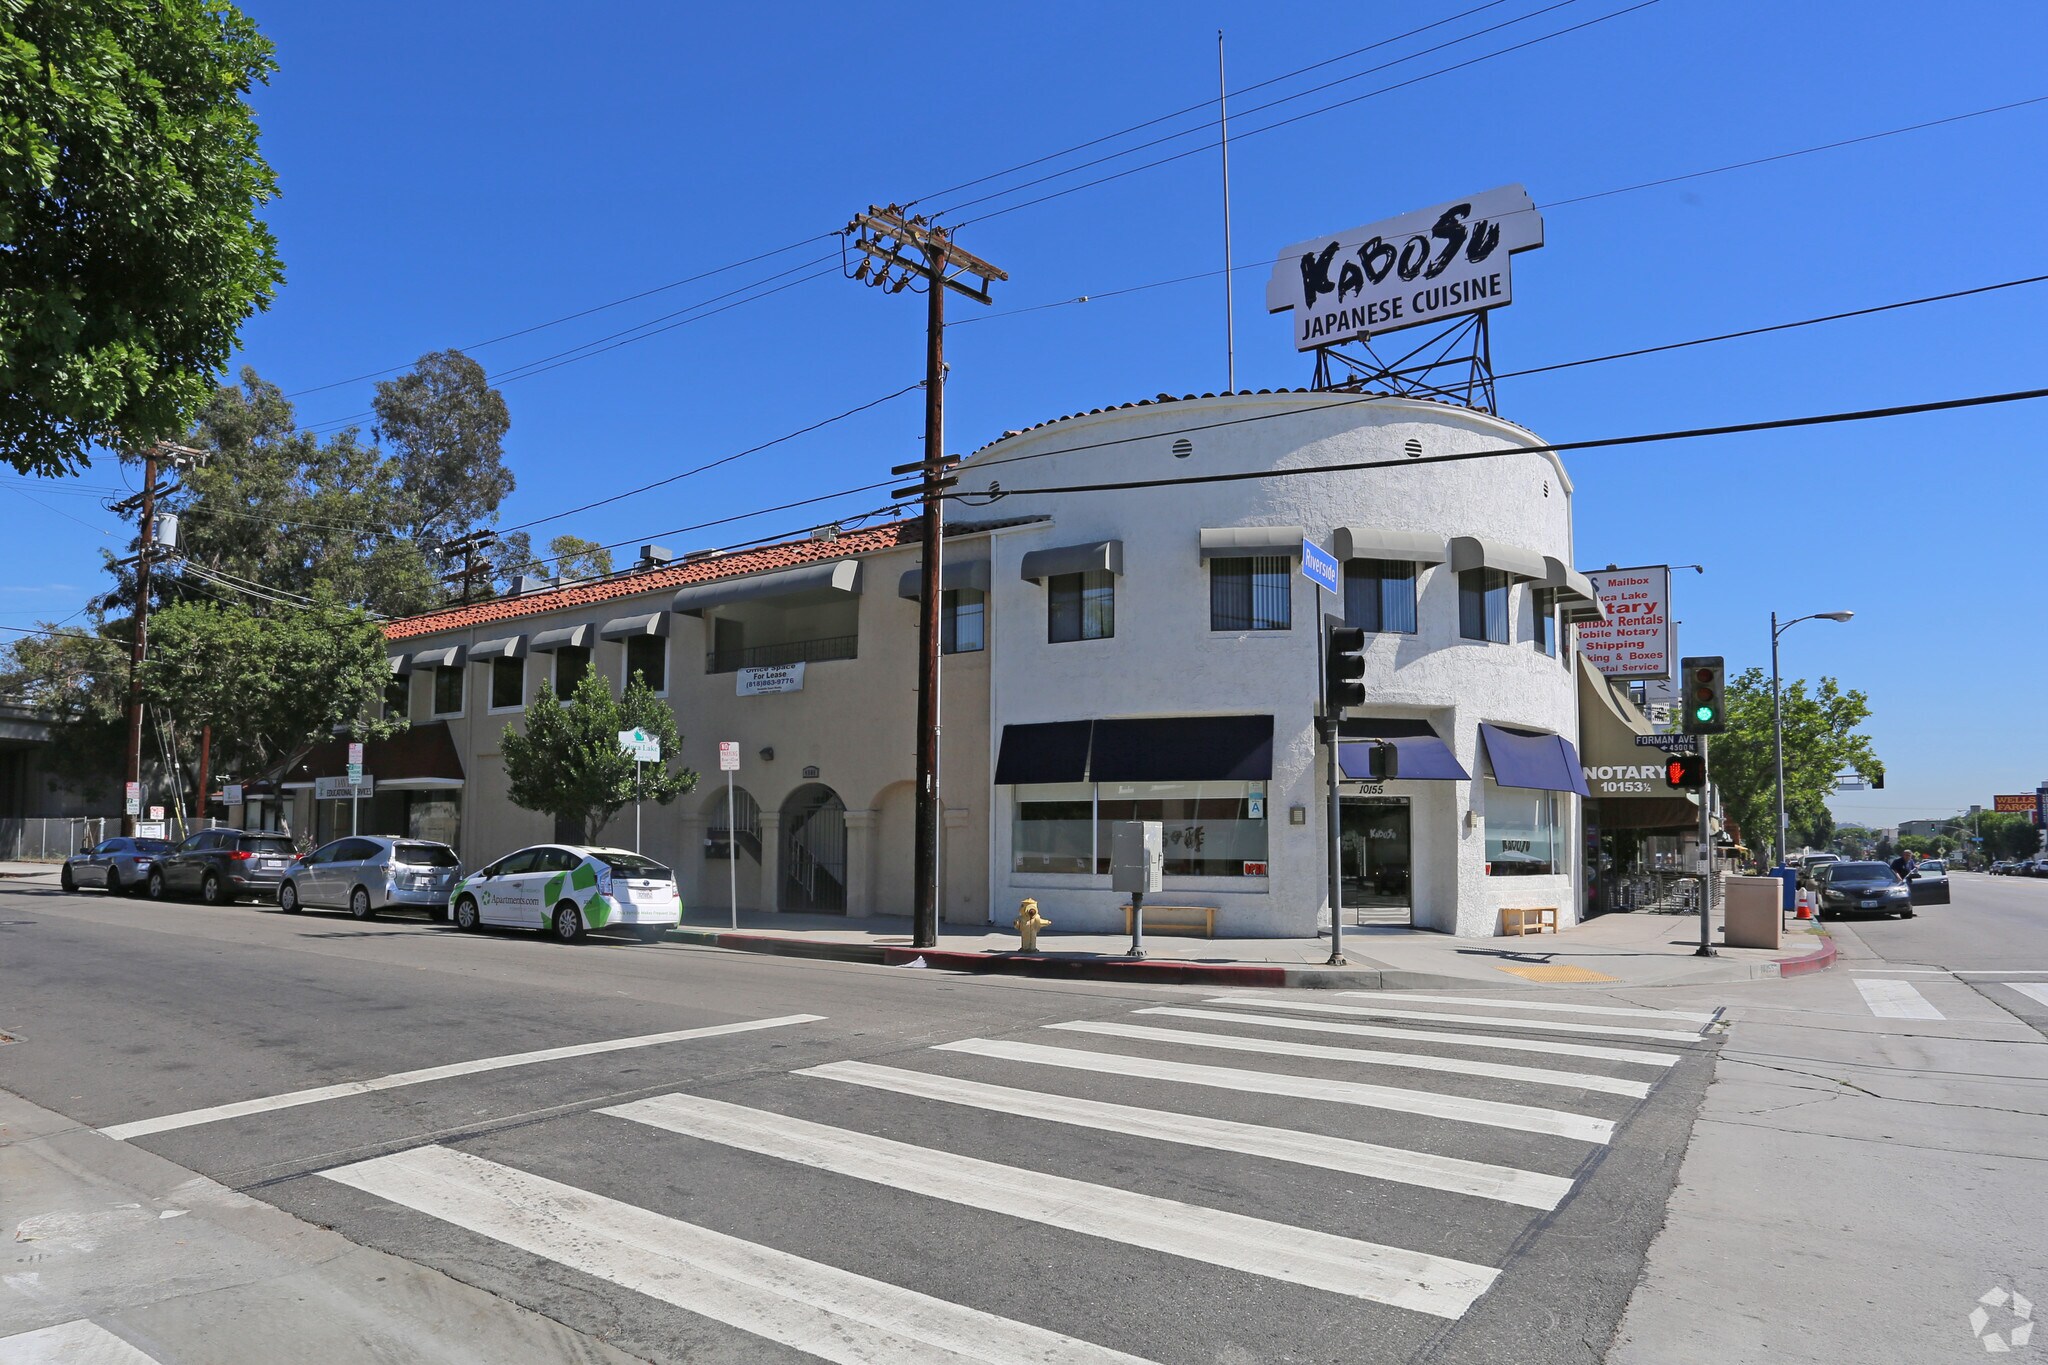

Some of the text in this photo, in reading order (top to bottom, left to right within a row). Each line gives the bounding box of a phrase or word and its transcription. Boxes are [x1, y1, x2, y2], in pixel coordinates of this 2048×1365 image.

[1302, 273, 1502, 341] JAPANESE CUISINE
[1305, 548, 1336, 583] Riverside
[1608, 577, 1649, 587] Mailbox
[1621, 591, 1648, 601] Lake
[1605, 602, 1658, 615] tary
[1577, 614, 1664, 629] ailbox Rentals
[1616, 627, 1659, 637] Notary
[1586, 641, 1645, 651] Shipping
[1615, 653, 1623, 661] &
[1629, 651, 1664, 660] Boxes
[1622, 663, 1659, 671] Service
[1636, 736, 1674, 745] FORMAN
[1583, 765, 1667, 780] NOTARY
[326, 789, 352, 797] EDUCATIONAL
[1359, 784, 1384, 795] 10155
[1996, 796, 2037, 804] WELLS
[1251, 802, 1260, 812] A
[1997, 803, 2037, 811] FARGO
[1244, 863, 1267, 875] OPEN
[491, 893, 540, 907] Apartments.com
